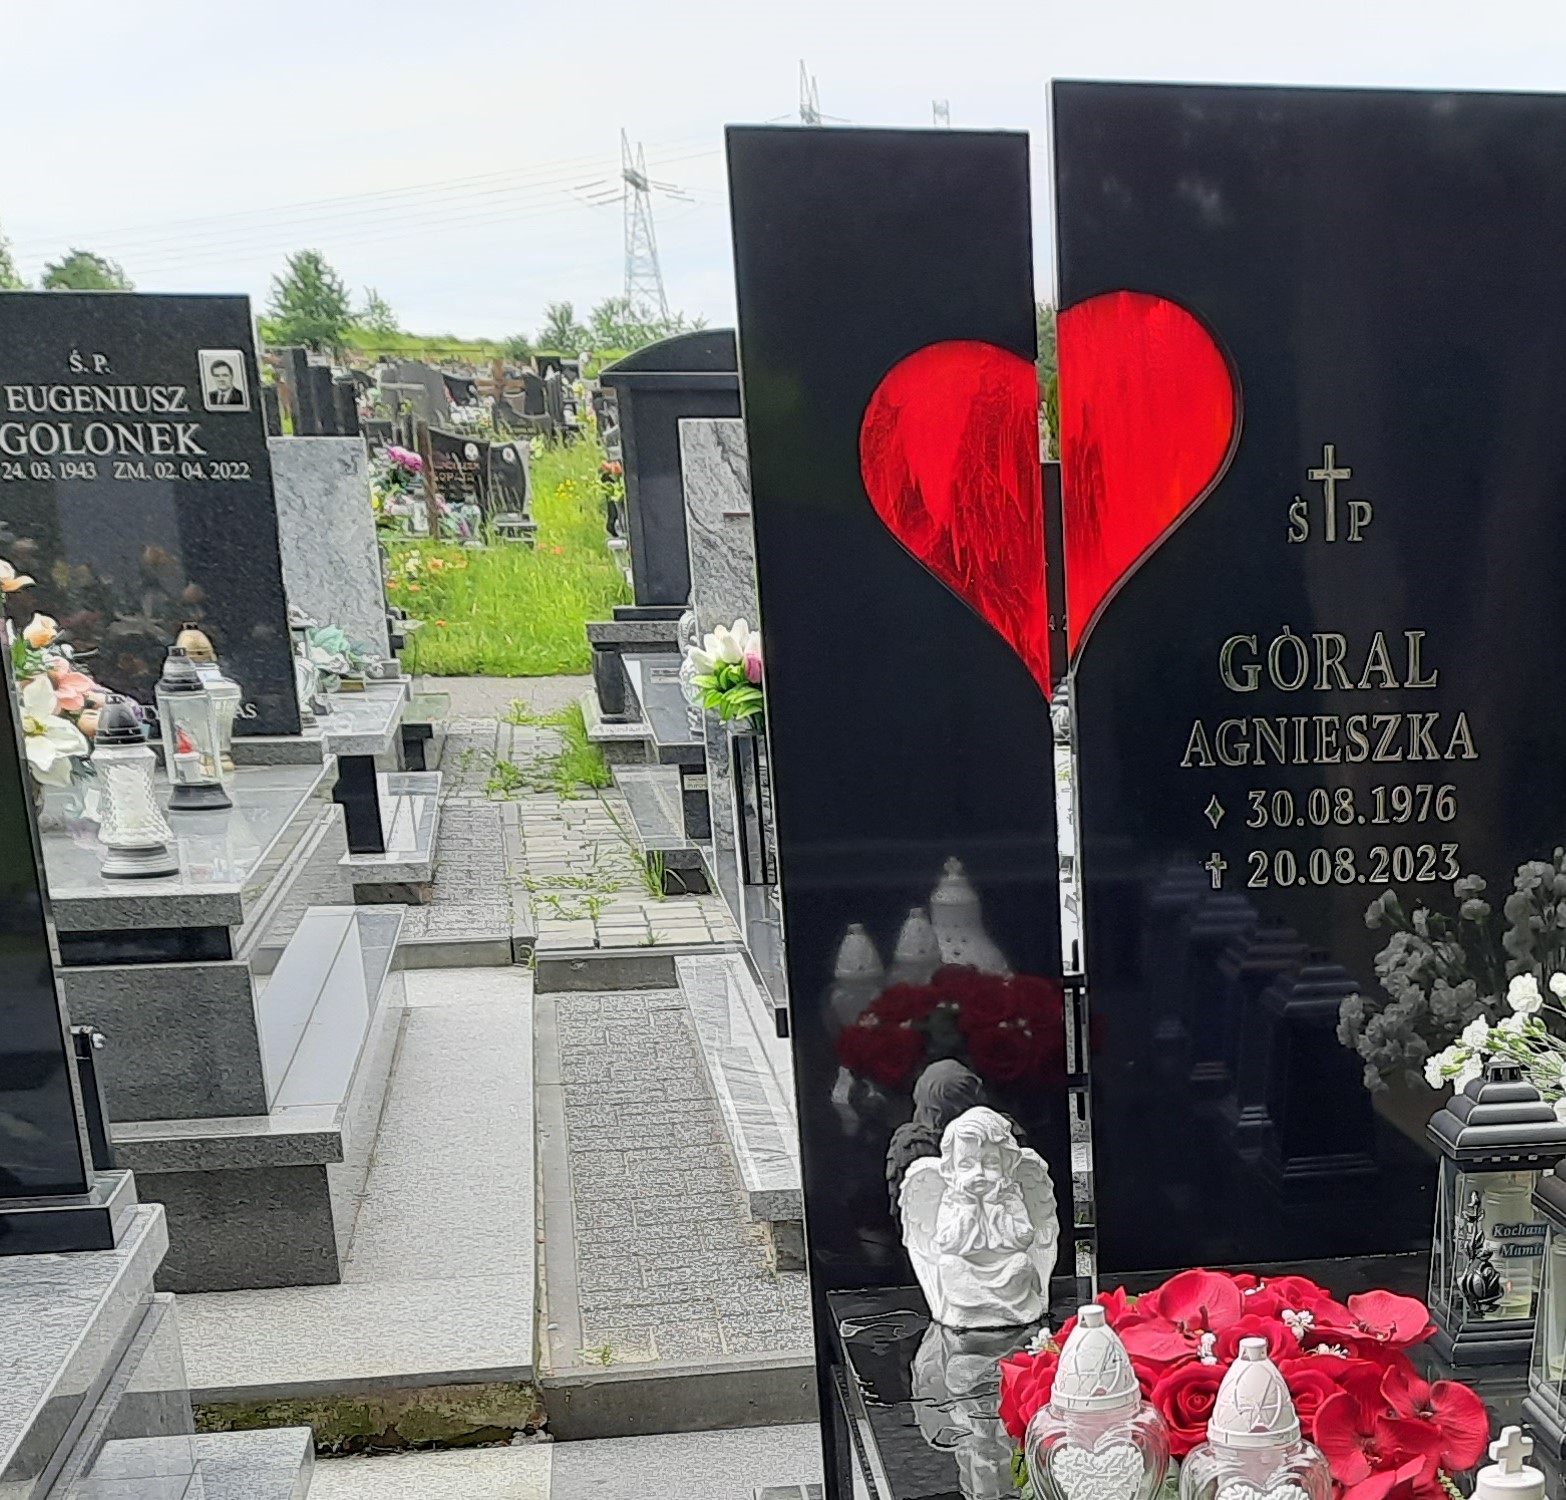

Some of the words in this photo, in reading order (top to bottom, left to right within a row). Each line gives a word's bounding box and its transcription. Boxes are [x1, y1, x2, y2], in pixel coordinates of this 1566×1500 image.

[4, 385, 189, 412] EUGENIUSZ
[0, 421, 207, 456] GOLONEK
[113, 461, 152, 480] ZM.
[1346, 501, 1373, 542] P
[1180, 712, 1479, 768] AGNIESZKA
[1245, 784, 1457, 828] 30.08.1976
[1246, 843, 1461, 889] 20.08.2023
